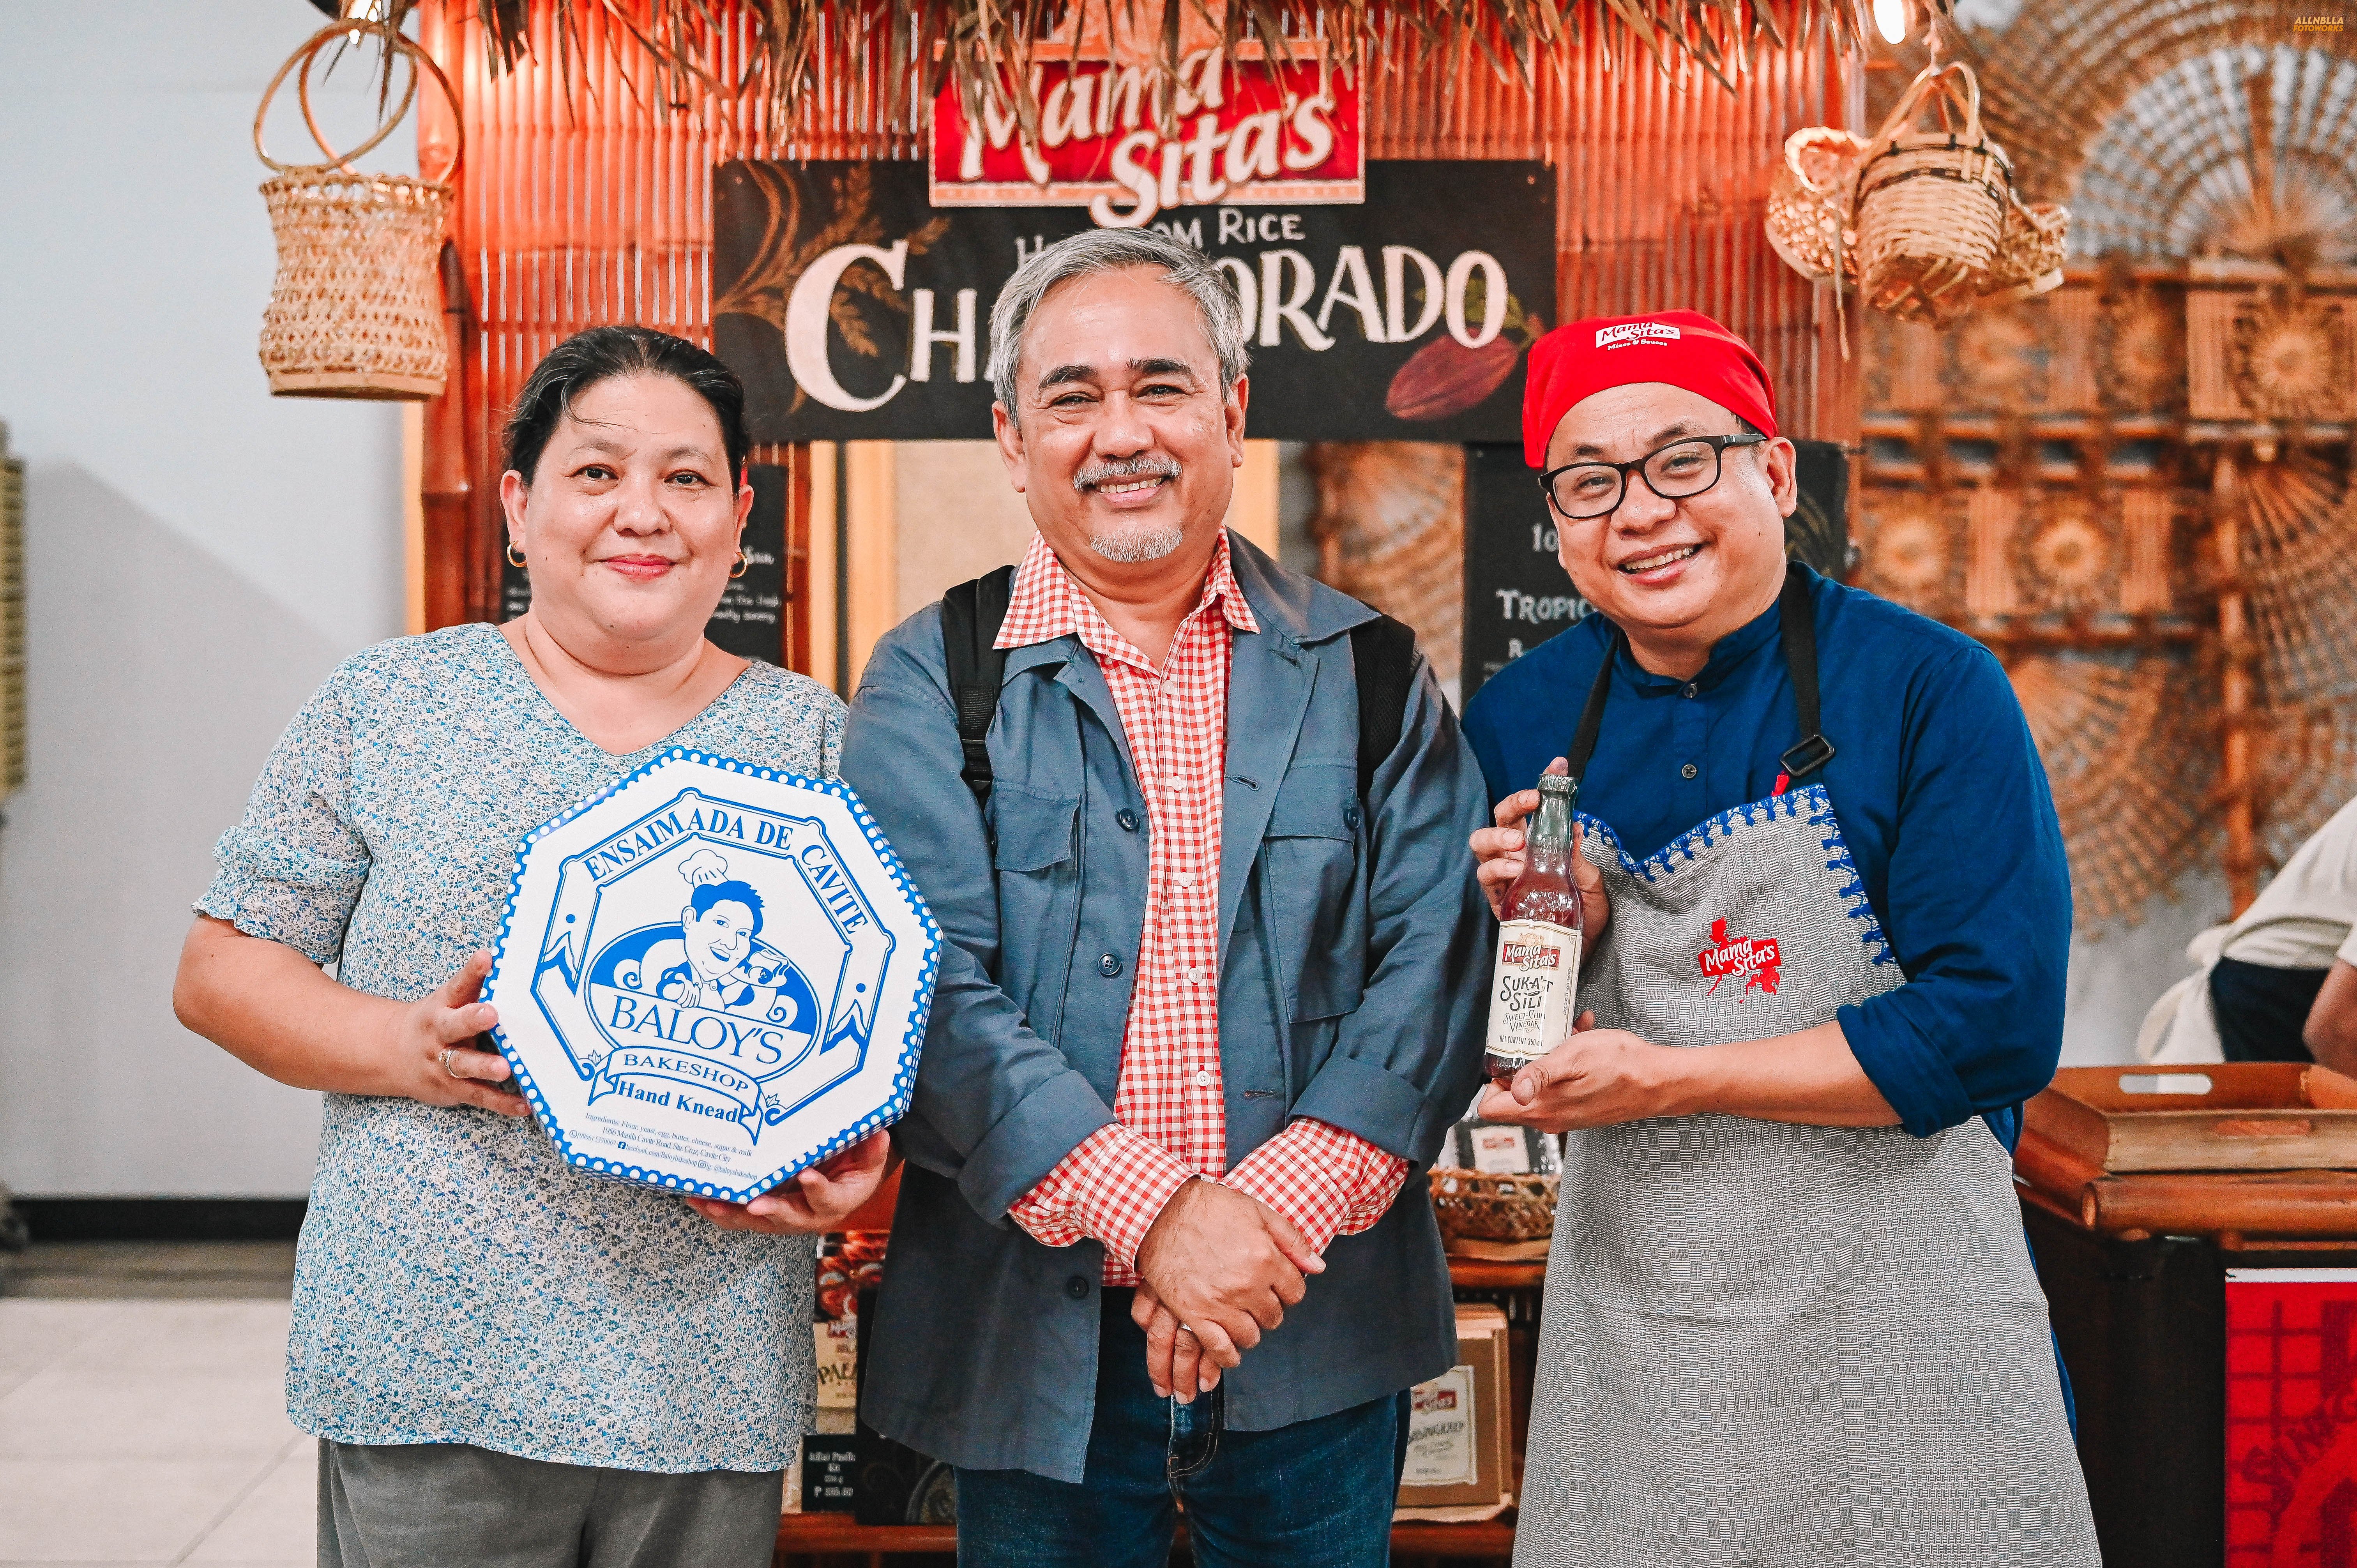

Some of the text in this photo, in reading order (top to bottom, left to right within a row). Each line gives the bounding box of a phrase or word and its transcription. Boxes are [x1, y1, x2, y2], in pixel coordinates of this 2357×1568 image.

[961, 47, 1224, 185] Mama
[1090, 94, 1335, 229] Sita's
[1218, 207, 1306, 245] RICE
[1601, 322, 1653, 342] Mama
[1607, 342, 1631, 351] Mixes
[1626, 328, 1673, 341] Sita's
[582, 807, 869, 935] ENSAIMADA DE CAVITE
[1504, 945, 1542, 963] Mama
[1519, 952, 1557, 972] Sita's
[1704, 939, 1753, 972] Mama
[1732, 945, 1775, 976] Sita's
[1509, 992, 1542, 1012] SILI
[609, 994, 784, 1064] BALOY'S
[1507, 1036, 1527, 1045] CONTENT
[1510, 1021, 1541, 1033] VINEGAR
[624, 1054, 749, 1091] BAKESHOP
[618, 1081, 739, 1123] Hand Knead
[617, 1130, 636, 1140] Manila
[637, 1134, 656, 1145] Cavite
[700, 1149, 718, 1160] Cavite
[719, 1154, 731, 1164] City
[714, 1143, 730, 1151] sugar
